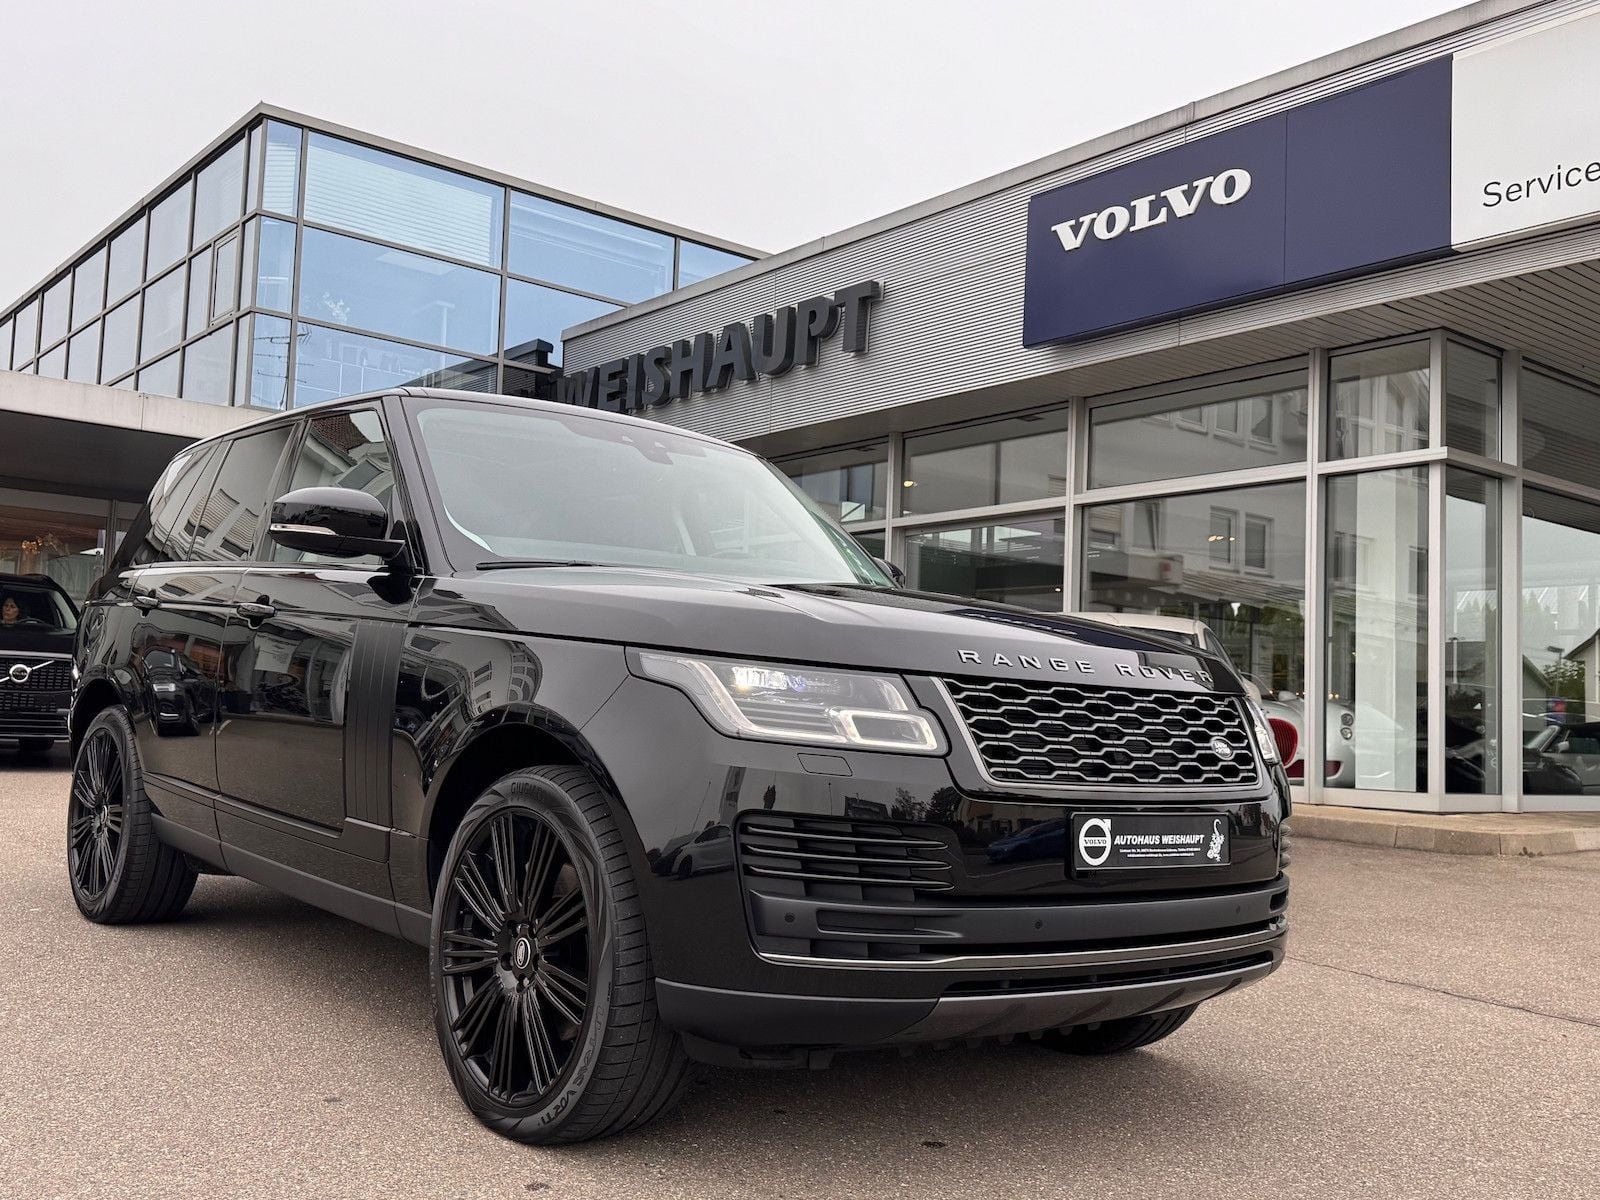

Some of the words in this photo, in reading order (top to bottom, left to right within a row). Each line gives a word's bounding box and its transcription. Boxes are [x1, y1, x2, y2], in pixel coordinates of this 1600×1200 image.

[1482, 161, 1600, 208] Service
[1051, 168, 1252, 251] VOLVO
[556, 280, 881, 413] WEISHAUPT
[958, 649, 1096, 673] RANGE
[1115, 663, 1214, 683] ROVER
[1114, 835, 1160, 845] AUTOHAUS
[1161, 834, 1205, 845] WEISHAUPT
